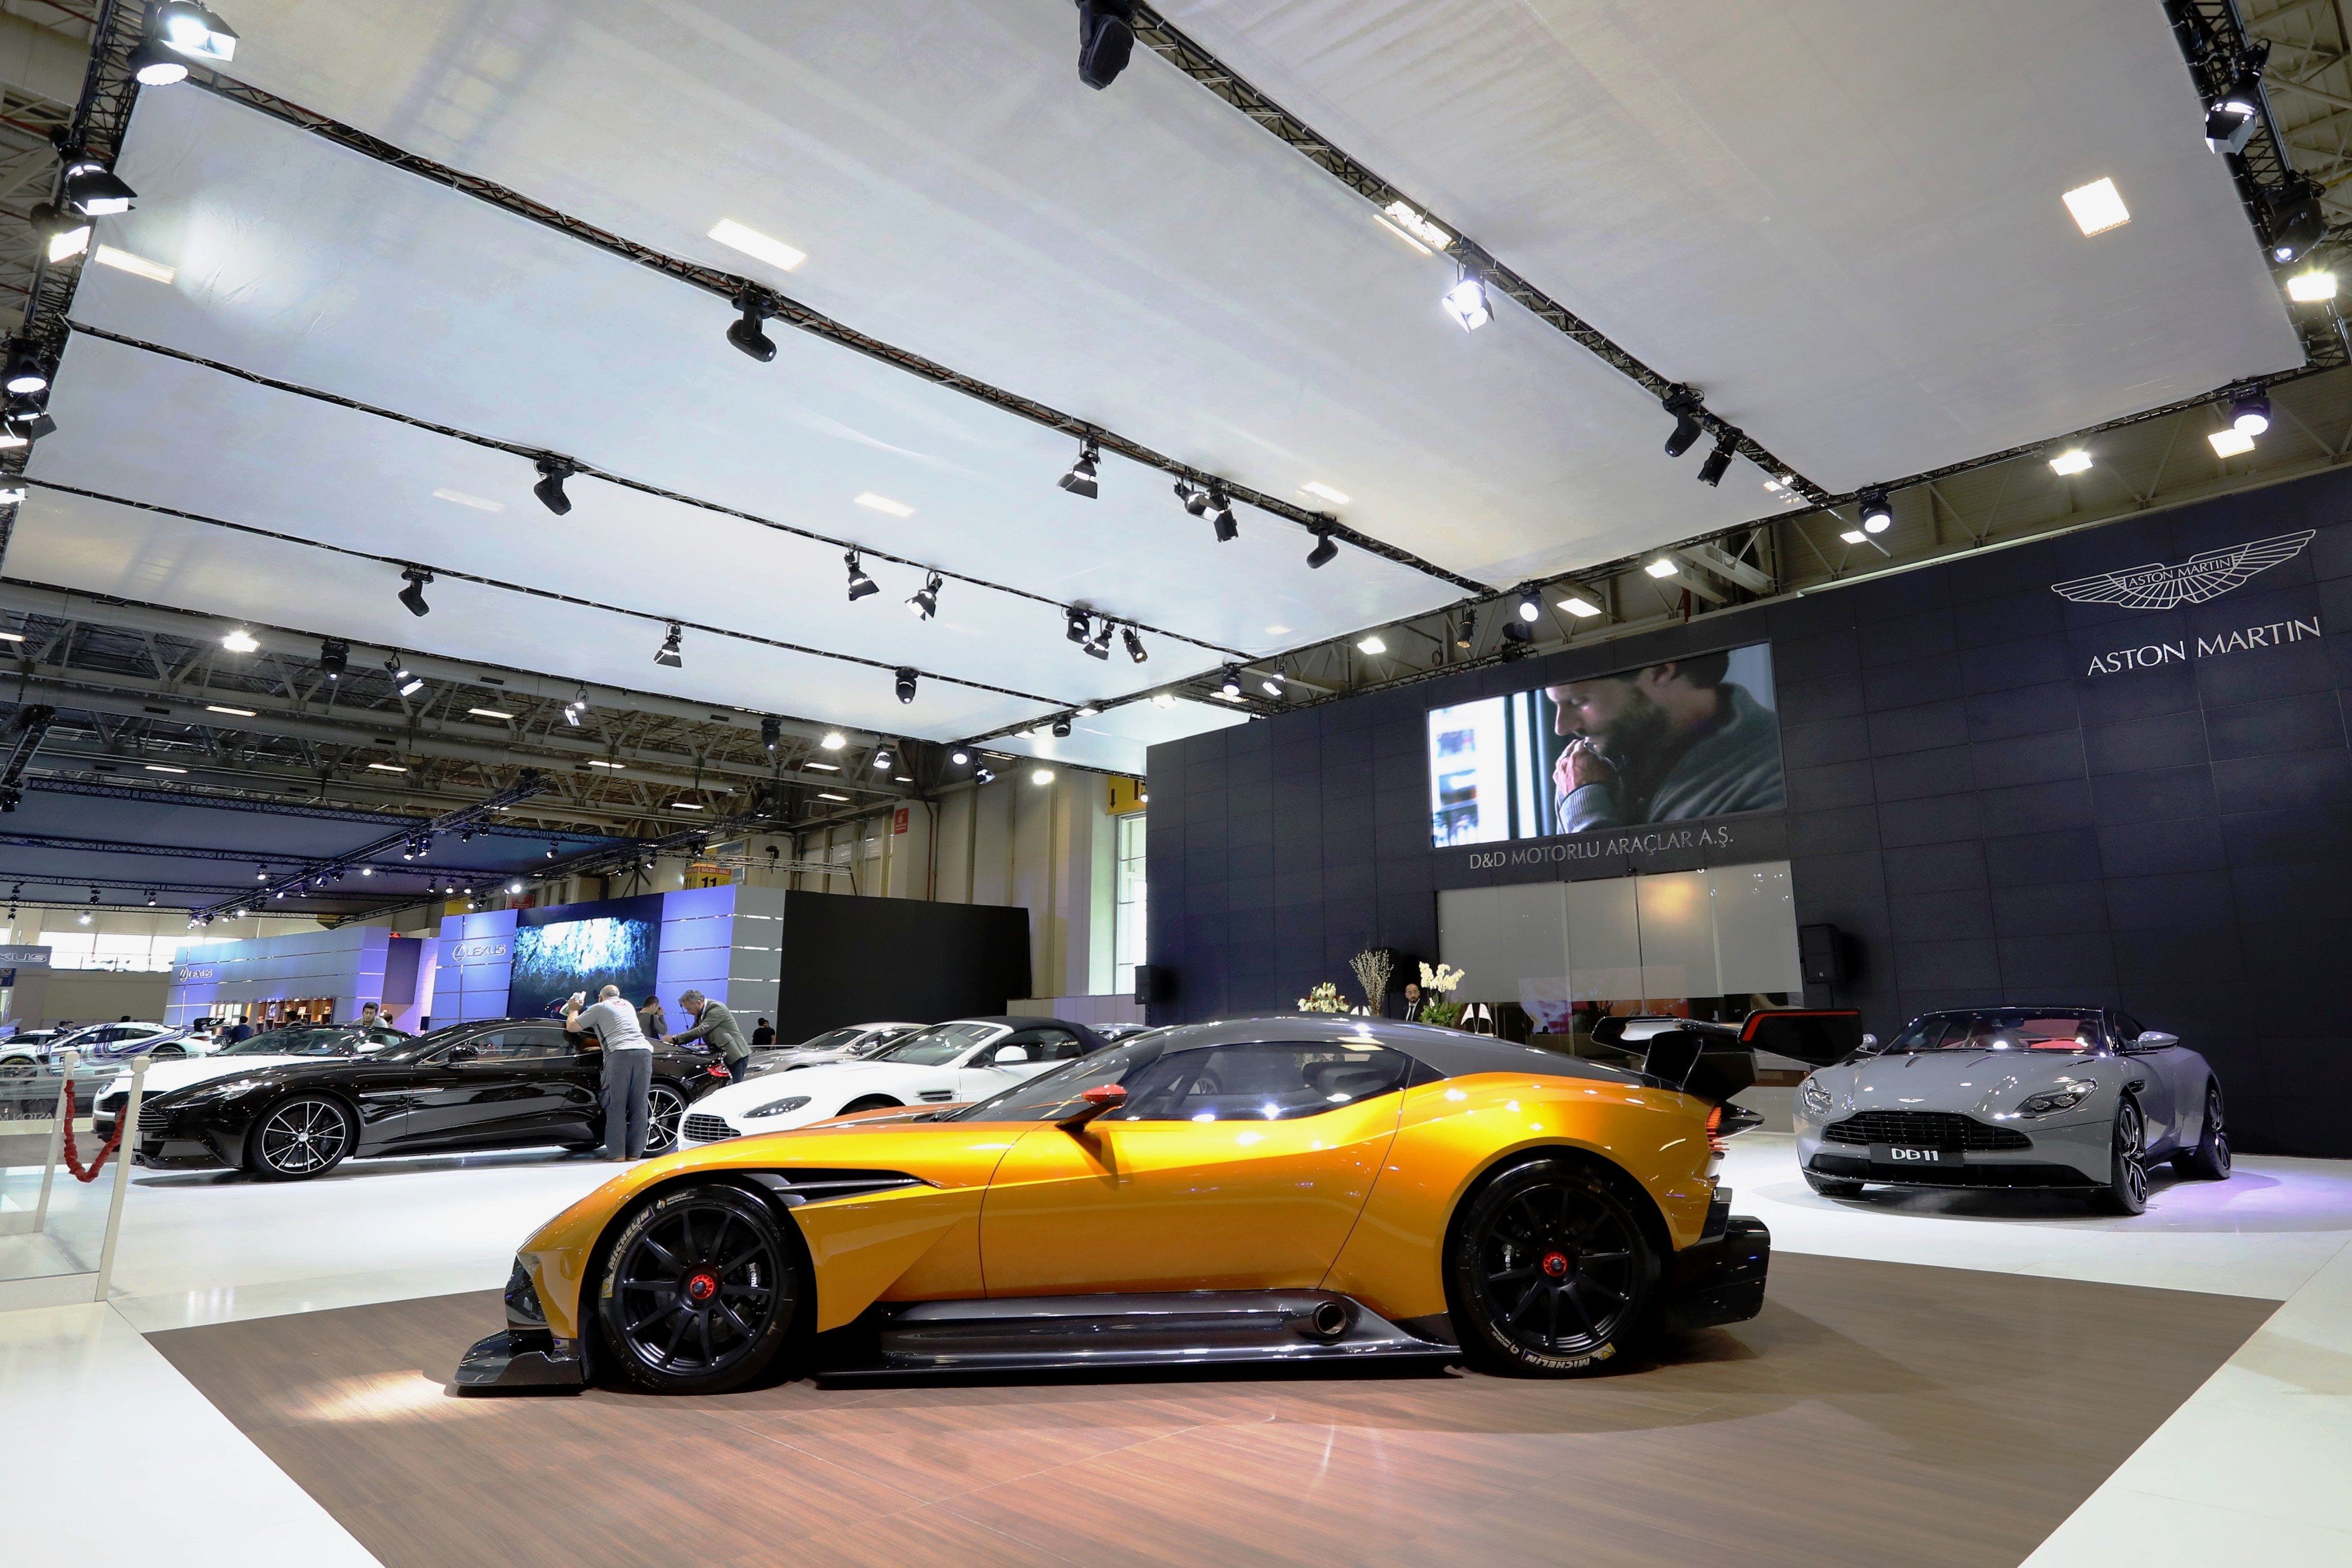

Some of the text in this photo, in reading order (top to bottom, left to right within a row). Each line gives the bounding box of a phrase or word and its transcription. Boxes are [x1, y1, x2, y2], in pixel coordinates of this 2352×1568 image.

[2128, 556, 2231, 588] ASTON MARTIN
[2087, 616, 2322, 676] ASTON MARTIN
[1469, 826, 1735, 870] D&D MOTORLU ARAÇLAR A.Ş.
[701, 877, 717, 888] 11
[0, 952, 47, 962] XUS
[467, 944, 506, 956] LEXUS
[1891, 1148, 1939, 1161] DB11
[607, 1209, 650, 1271] MICHELIN
[749, 1262, 758, 1288] brem
[1525, 1354, 1590, 1368] MICHELIN
